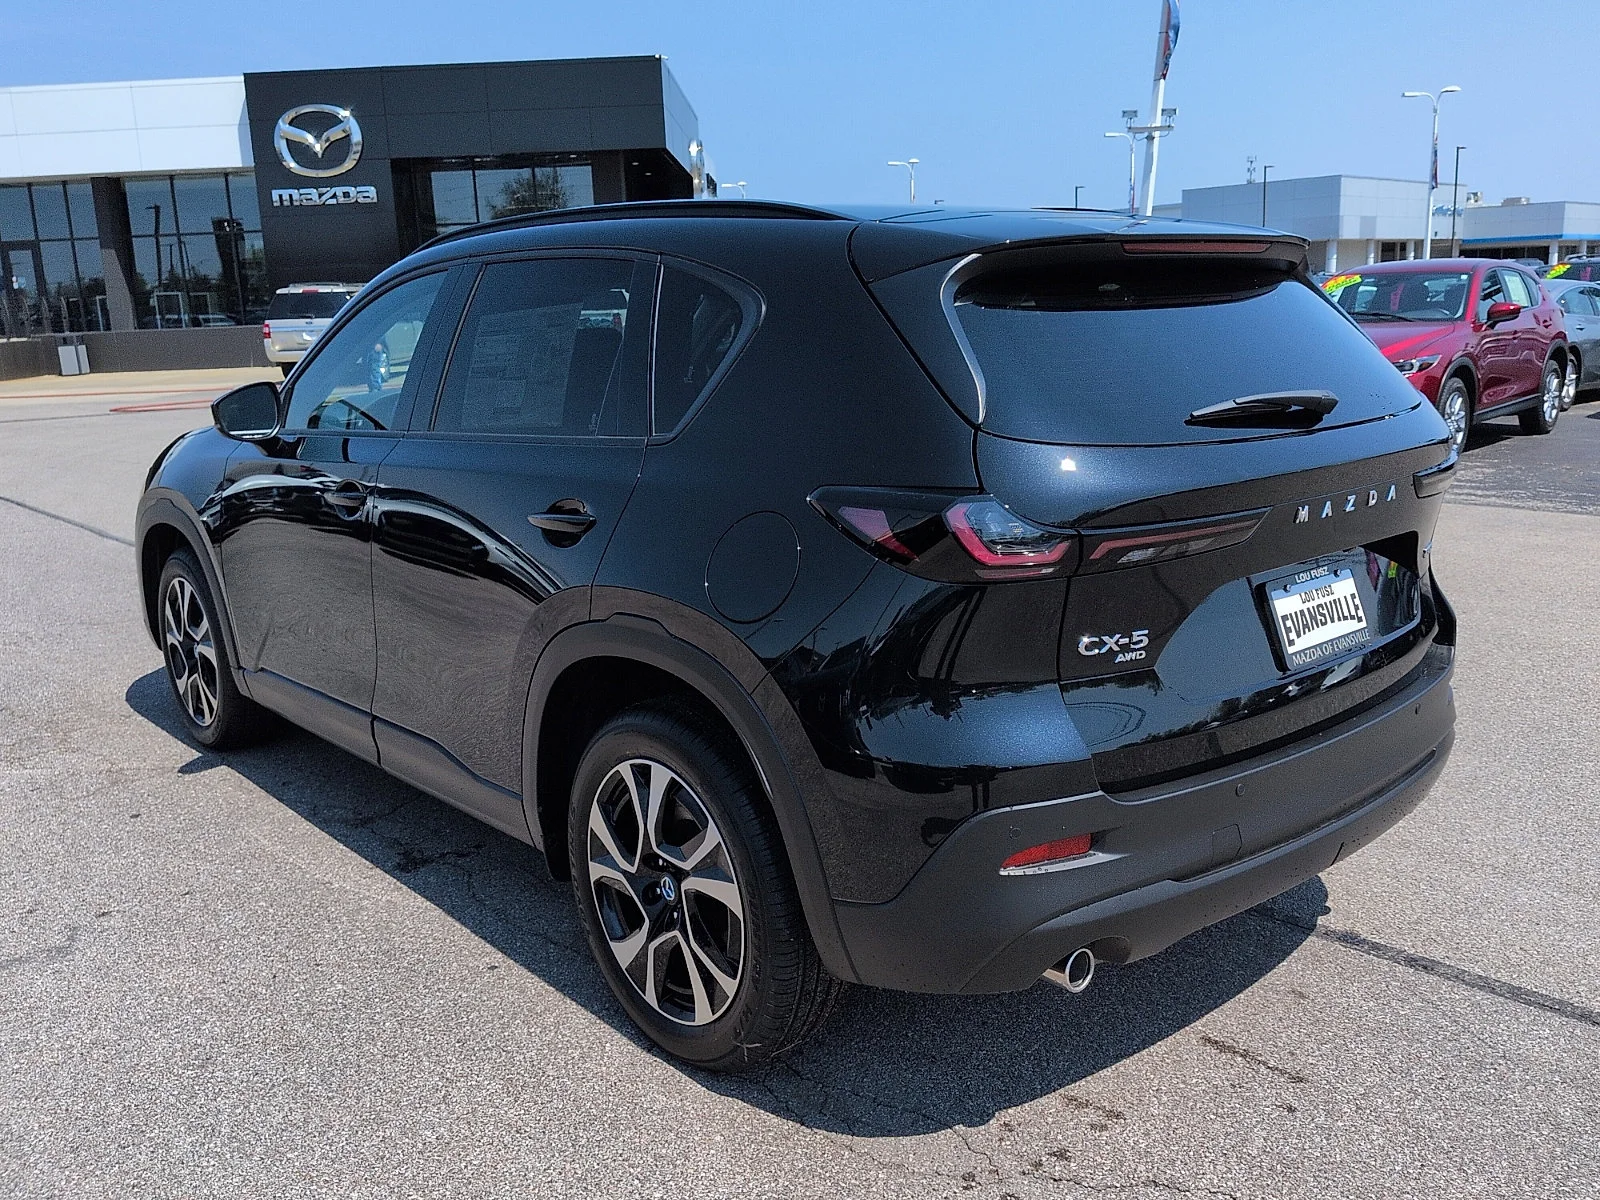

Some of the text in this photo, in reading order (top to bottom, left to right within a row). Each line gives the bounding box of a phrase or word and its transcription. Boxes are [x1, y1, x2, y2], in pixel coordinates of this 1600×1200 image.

[1293, 484, 1397, 524] MAZDA
[1295, 566, 1329, 583] LOU FUSZ
[1299, 584, 1335, 604] LOU FUSZ
[1280, 592, 1364, 648] EVANSVILLE
[1077, 629, 1149, 656] CX-5
[1292, 629, 1370, 666] MAZDA OF EVANSVILLE
[1114, 650, 1146, 664] AWD
